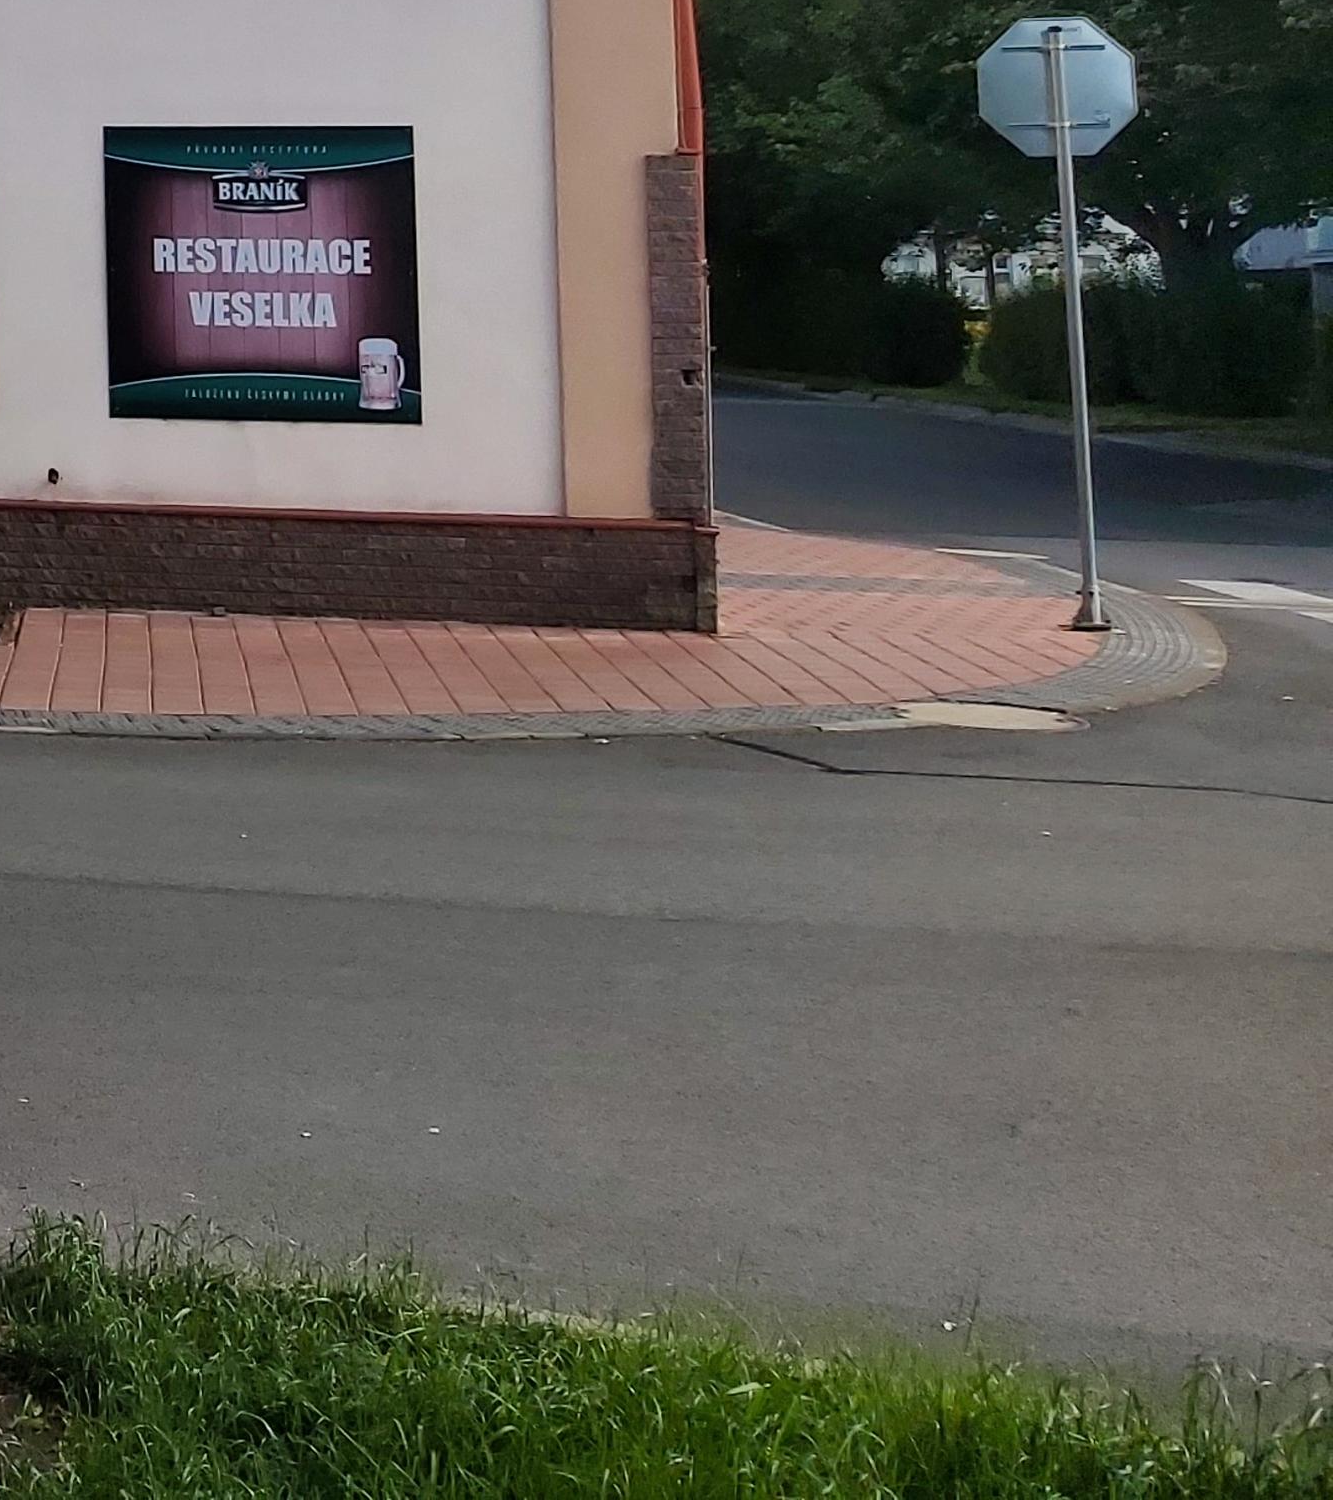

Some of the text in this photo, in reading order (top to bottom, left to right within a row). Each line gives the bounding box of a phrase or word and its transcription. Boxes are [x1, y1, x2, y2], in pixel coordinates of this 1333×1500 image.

[218, 179, 300, 201] BRANÍK
[153, 238, 372, 275] RESTAURACE
[188, 291, 337, 328] VESELKA
